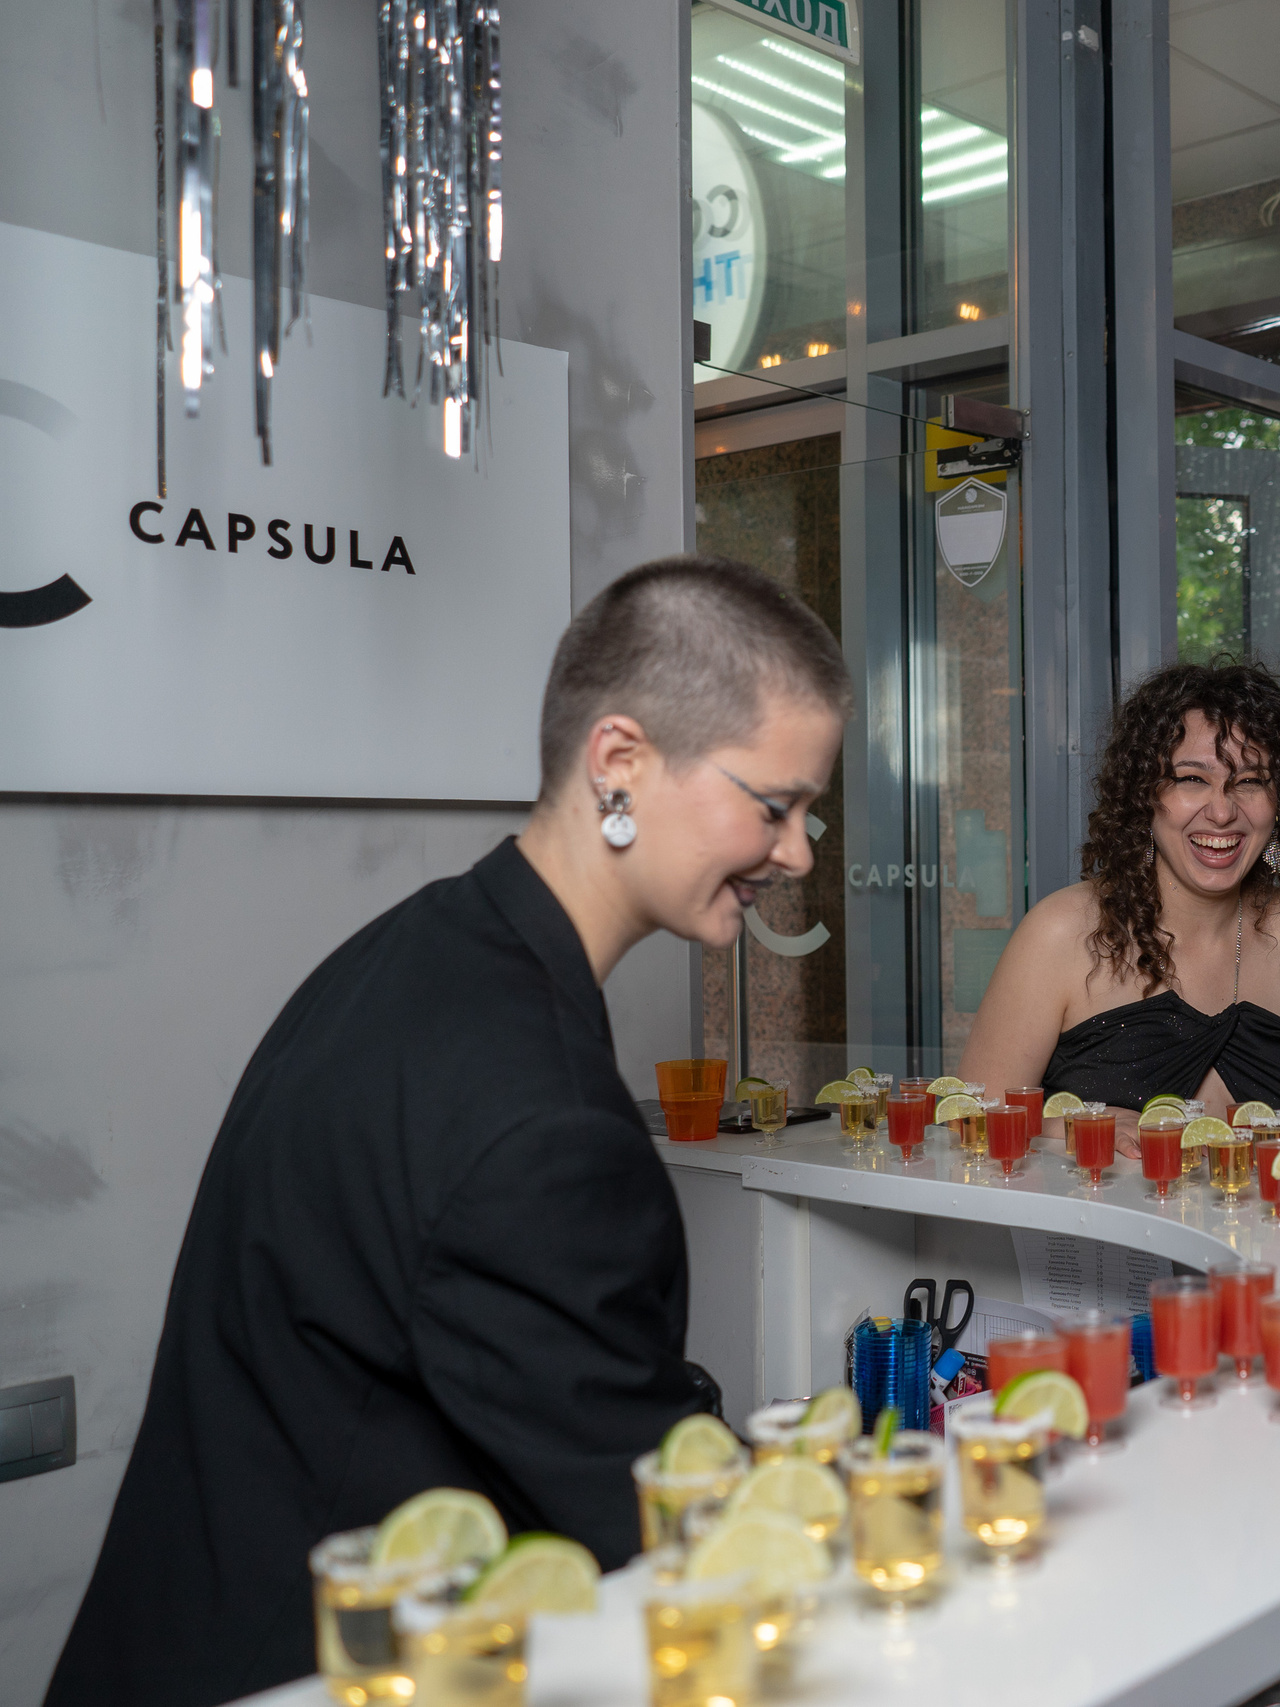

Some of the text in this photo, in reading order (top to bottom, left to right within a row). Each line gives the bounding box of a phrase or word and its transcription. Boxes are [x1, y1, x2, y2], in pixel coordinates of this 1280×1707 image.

[751, 0, 841, 46] ХОД
[129, 500, 417, 576] CAPSULA
[848, 863, 976, 888] CAPSULA
